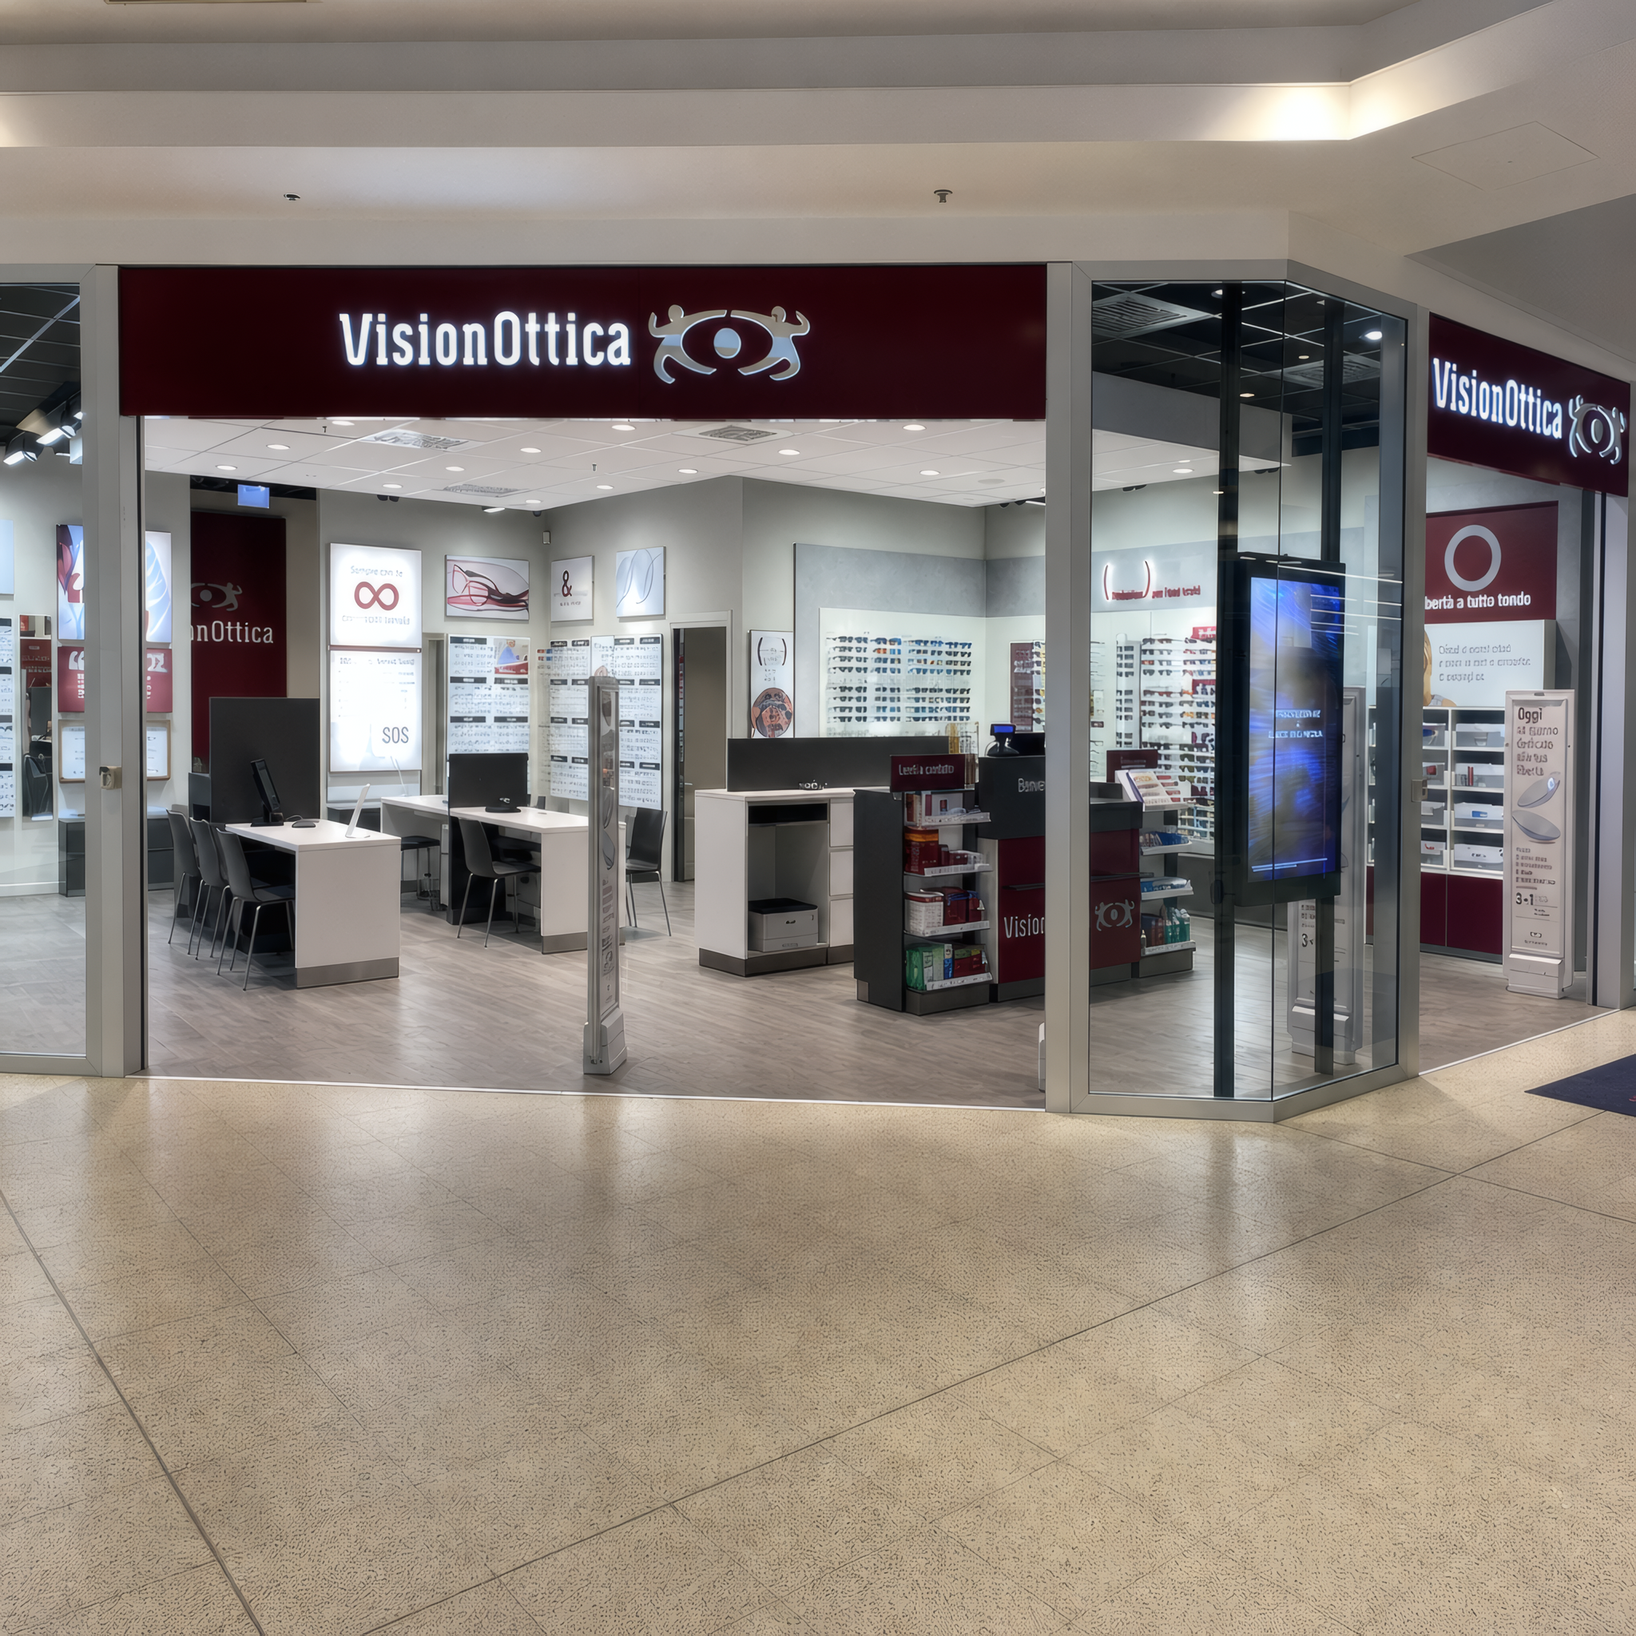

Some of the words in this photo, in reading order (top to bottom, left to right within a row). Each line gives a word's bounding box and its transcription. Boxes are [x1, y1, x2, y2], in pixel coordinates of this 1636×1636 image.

[339, 311, 632, 366] VisionOttica
[1432, 357, 1563, 439] VisionOttica
[1497, 591, 1532, 607] tondo
[1517, 706, 1543, 724] Oggi
[381, 726, 410, 744] SOS
